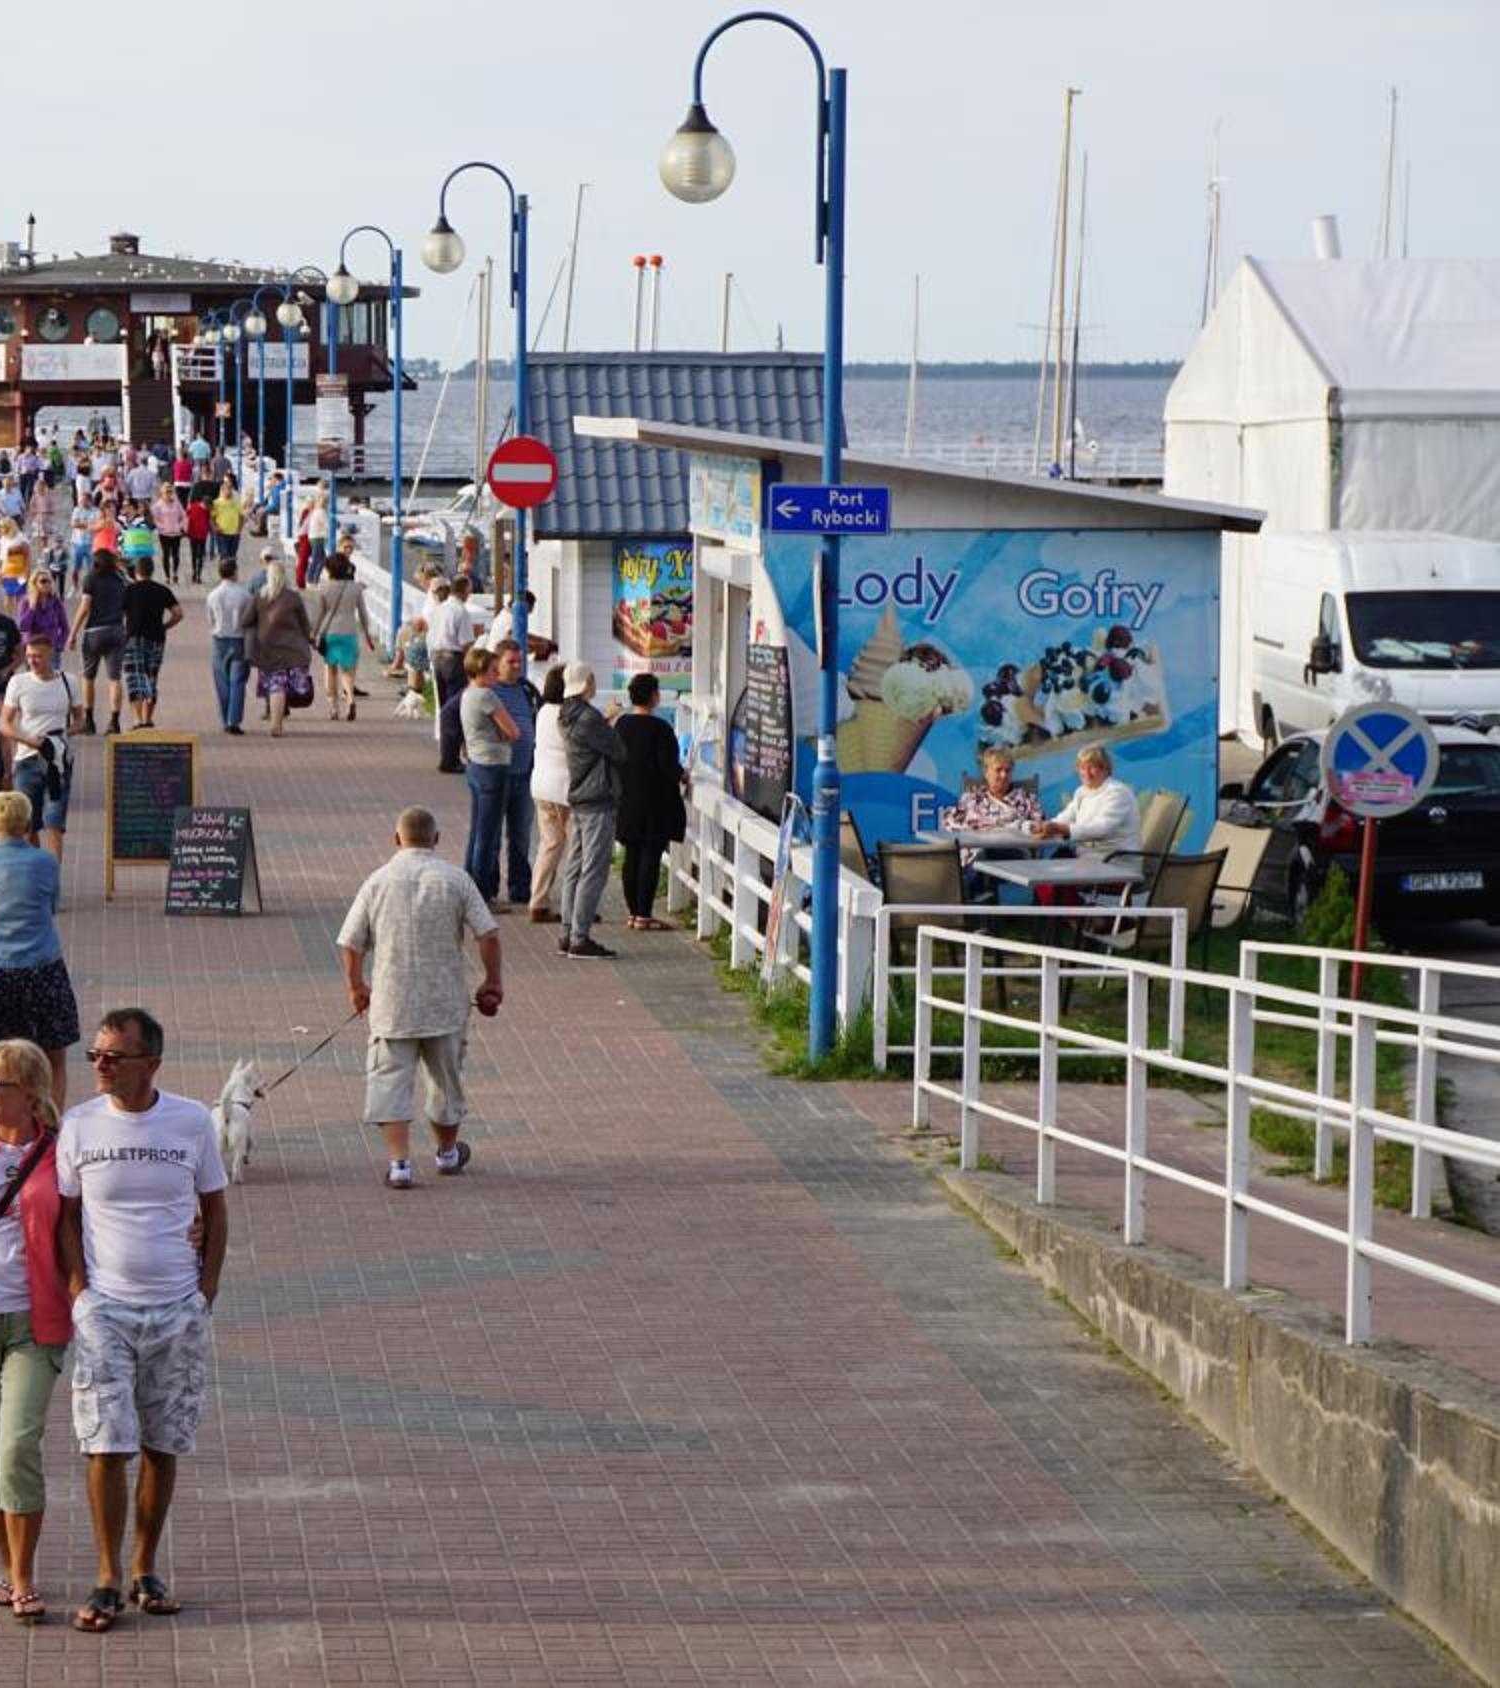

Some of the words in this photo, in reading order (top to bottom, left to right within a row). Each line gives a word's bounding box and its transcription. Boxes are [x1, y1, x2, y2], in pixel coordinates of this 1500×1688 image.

[830, 489, 864, 507] Port
[811, 508, 880, 529] Rybacki
[1018, 570, 1163, 630] Gofry
[81, 1148, 188, 1162] BULLETPROOF
